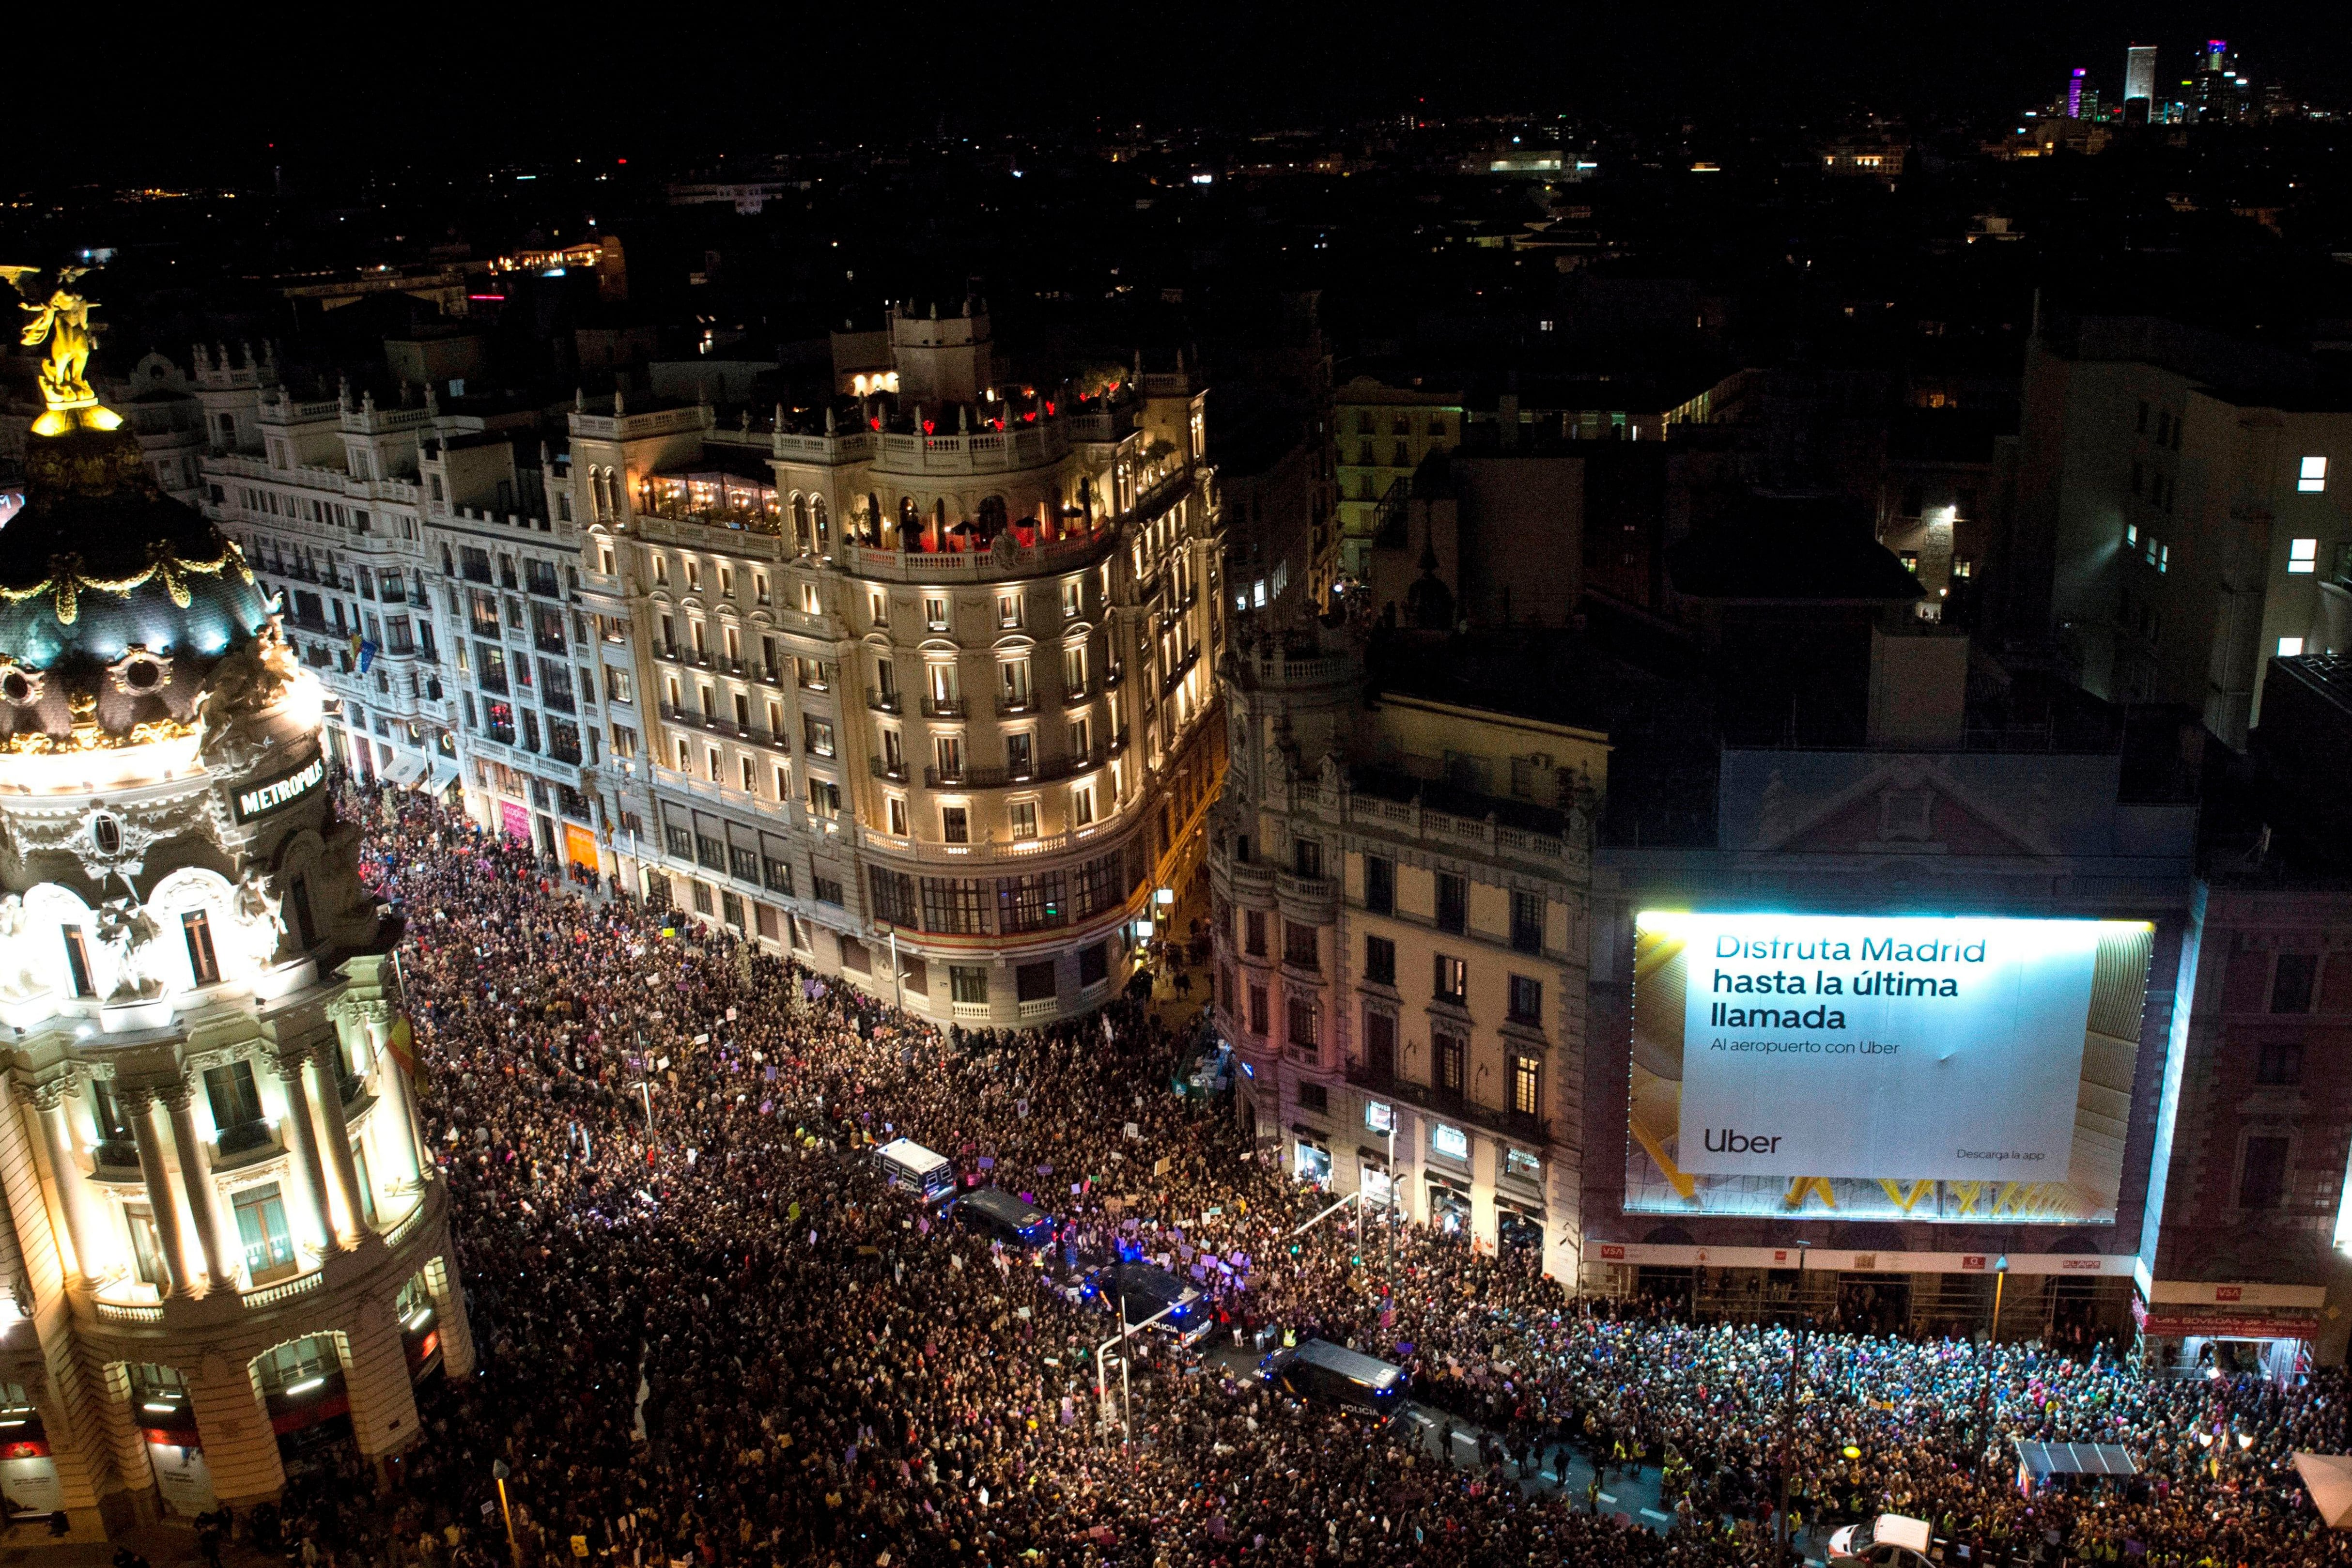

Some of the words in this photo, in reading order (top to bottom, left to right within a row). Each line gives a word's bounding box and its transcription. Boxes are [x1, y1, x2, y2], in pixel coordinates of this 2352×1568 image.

[241, 758, 324, 816] METROPOLIS
[1716, 935, 1851, 960] Disfruta
[1861, 937, 1985, 963] Madrid
[1713, 968, 1807, 994] hasta
[1816, 970, 1843, 995] la
[1853, 970, 1958, 997] última
[1711, 1002, 1847, 1029] llamada
[1710, 1038, 1727, 1051] Al
[1731, 1040, 1821, 1054] aeropuerto
[1825, 1041, 1856, 1053] con
[1859, 1041, 1901, 1055] Uber
[1704, 1128, 1782, 1154] Uber
[1957, 1149, 2009, 1161] Descarga
[2012, 1150, 2020, 1159] la
[2023, 1152, 2045, 1162] app
[1148, 1320, 1179, 1334] OLICIA
